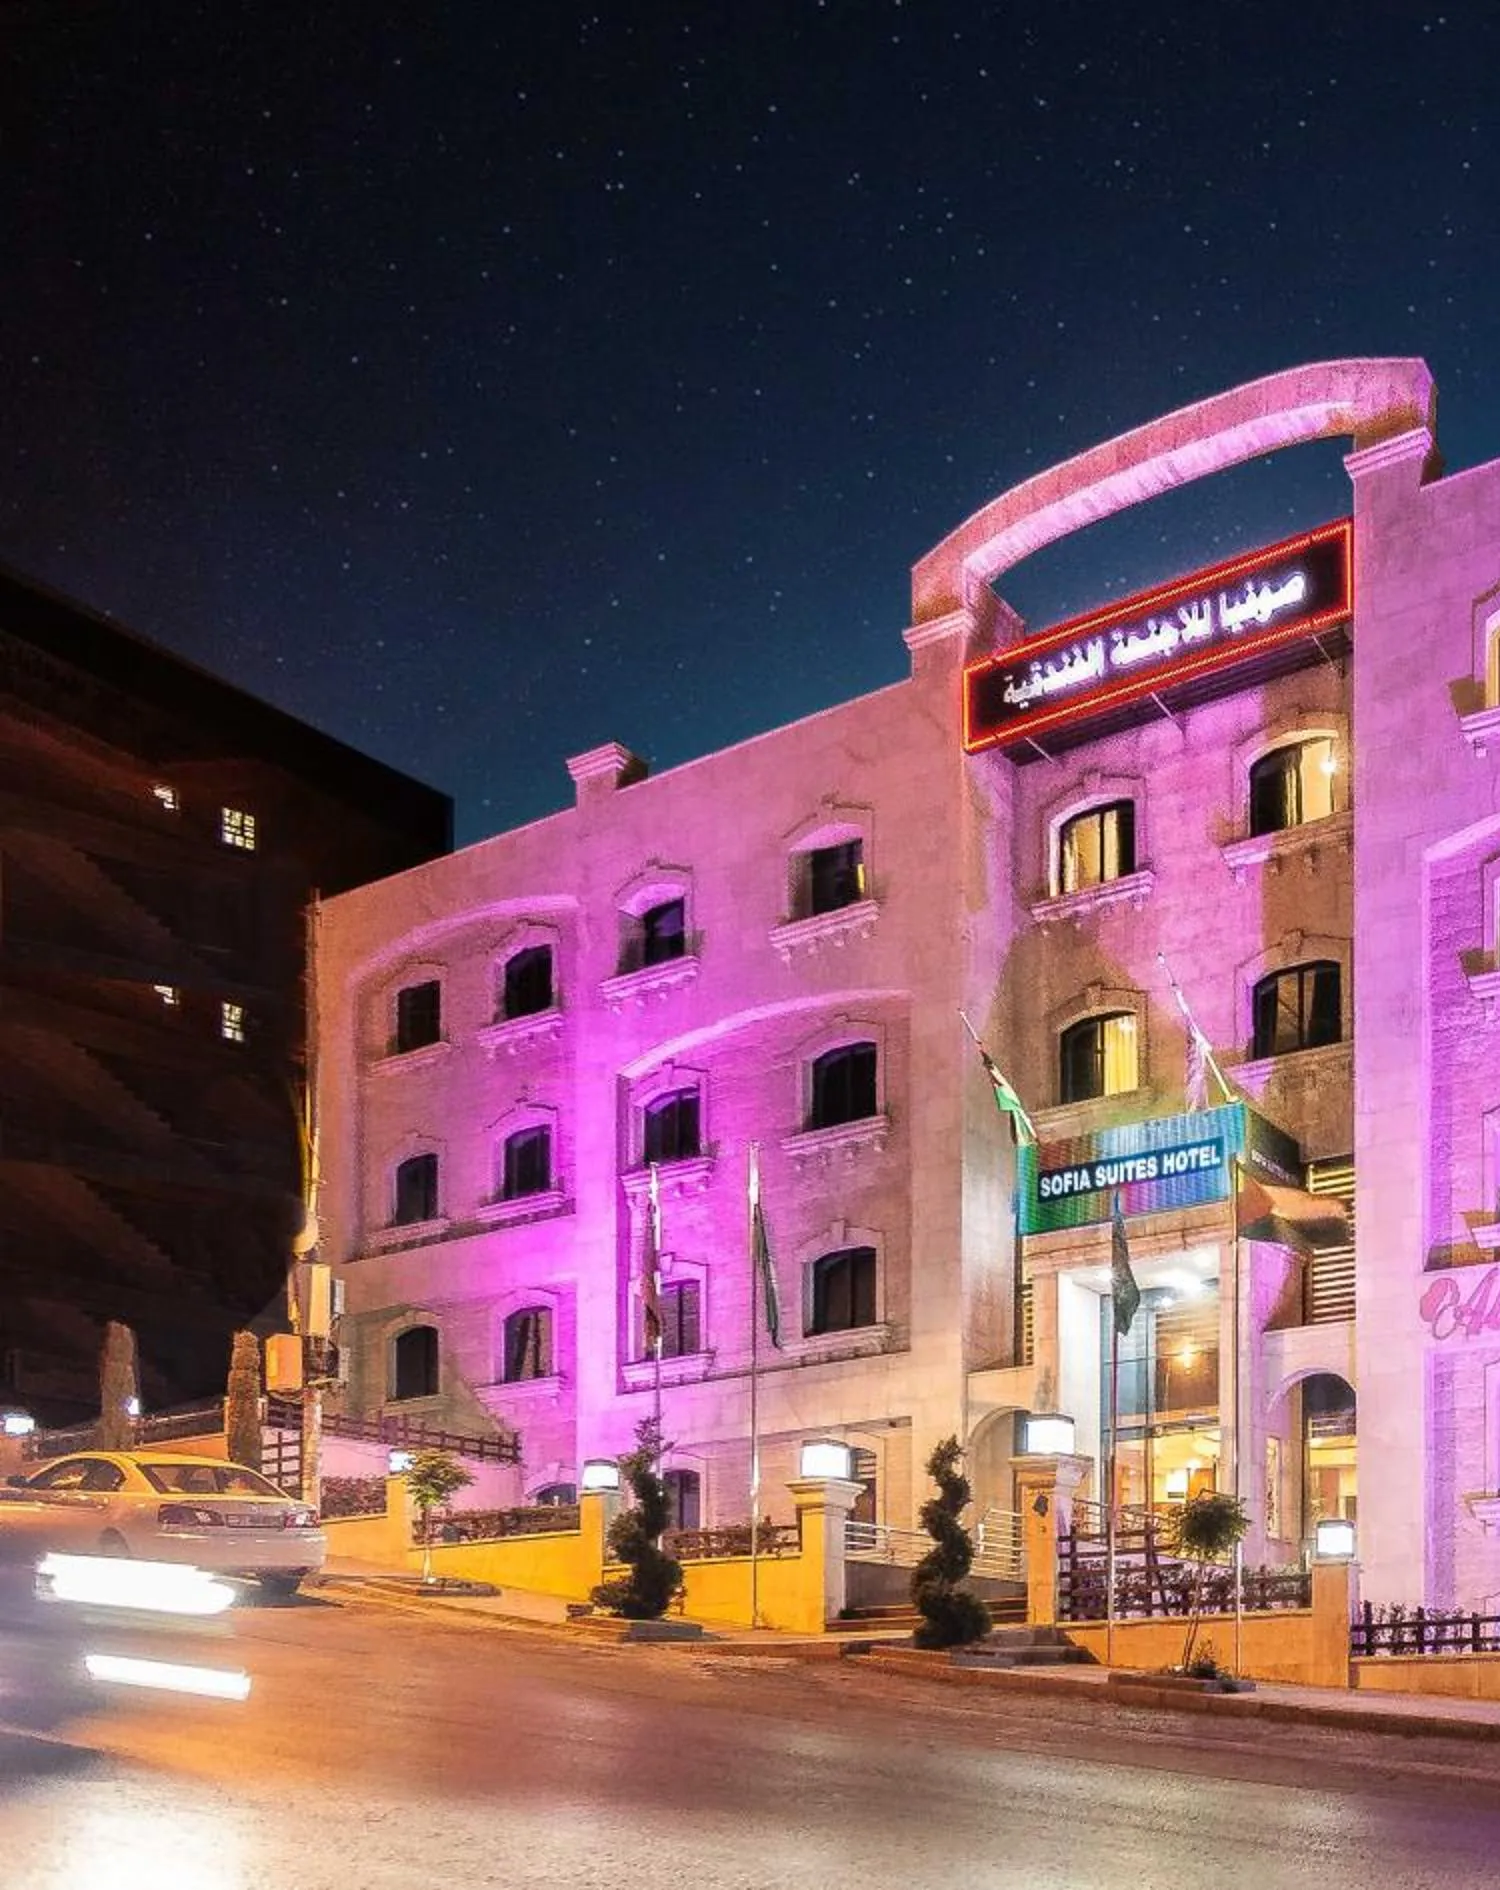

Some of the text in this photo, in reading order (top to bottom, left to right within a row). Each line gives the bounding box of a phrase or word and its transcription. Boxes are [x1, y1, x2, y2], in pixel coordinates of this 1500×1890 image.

[1219, 572, 1305, 632] صوفيا
[1040, 1169, 1091, 1197] SOFIA
[1095, 1157, 1157, 1187] SUITES
[1162, 1145, 1220, 1175] HOTEL
